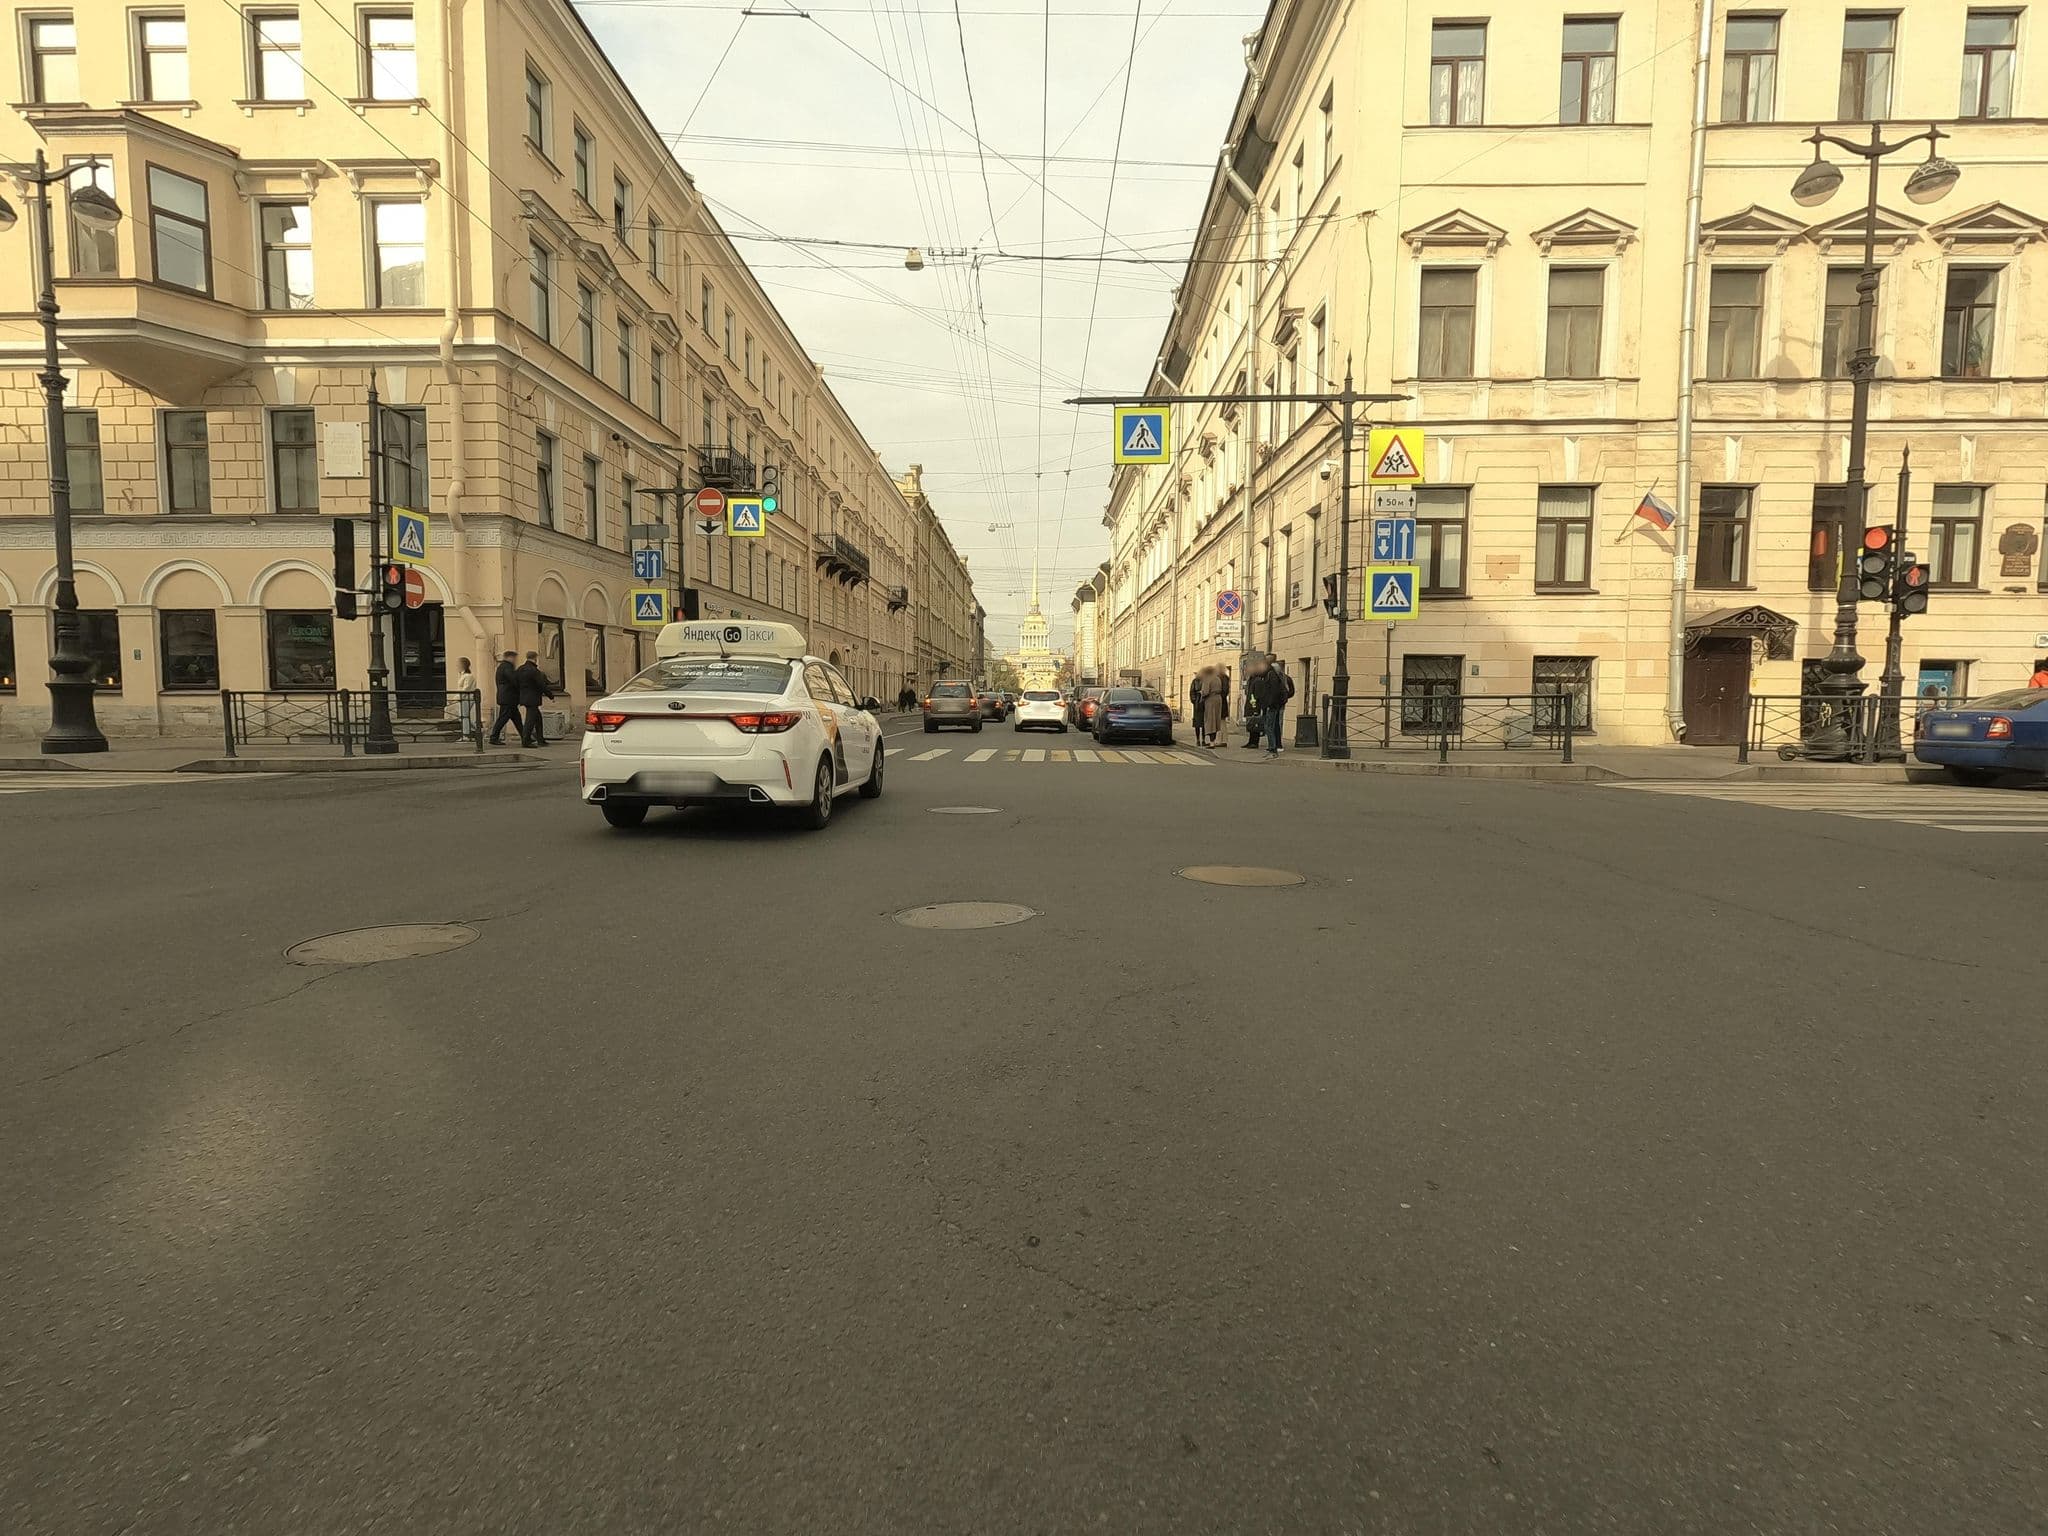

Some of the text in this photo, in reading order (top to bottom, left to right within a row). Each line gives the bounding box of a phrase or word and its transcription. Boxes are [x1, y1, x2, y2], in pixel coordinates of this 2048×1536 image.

[1386, 498, 1397, 506] 50
[683, 627, 774, 641] Яндекс Go Такси
